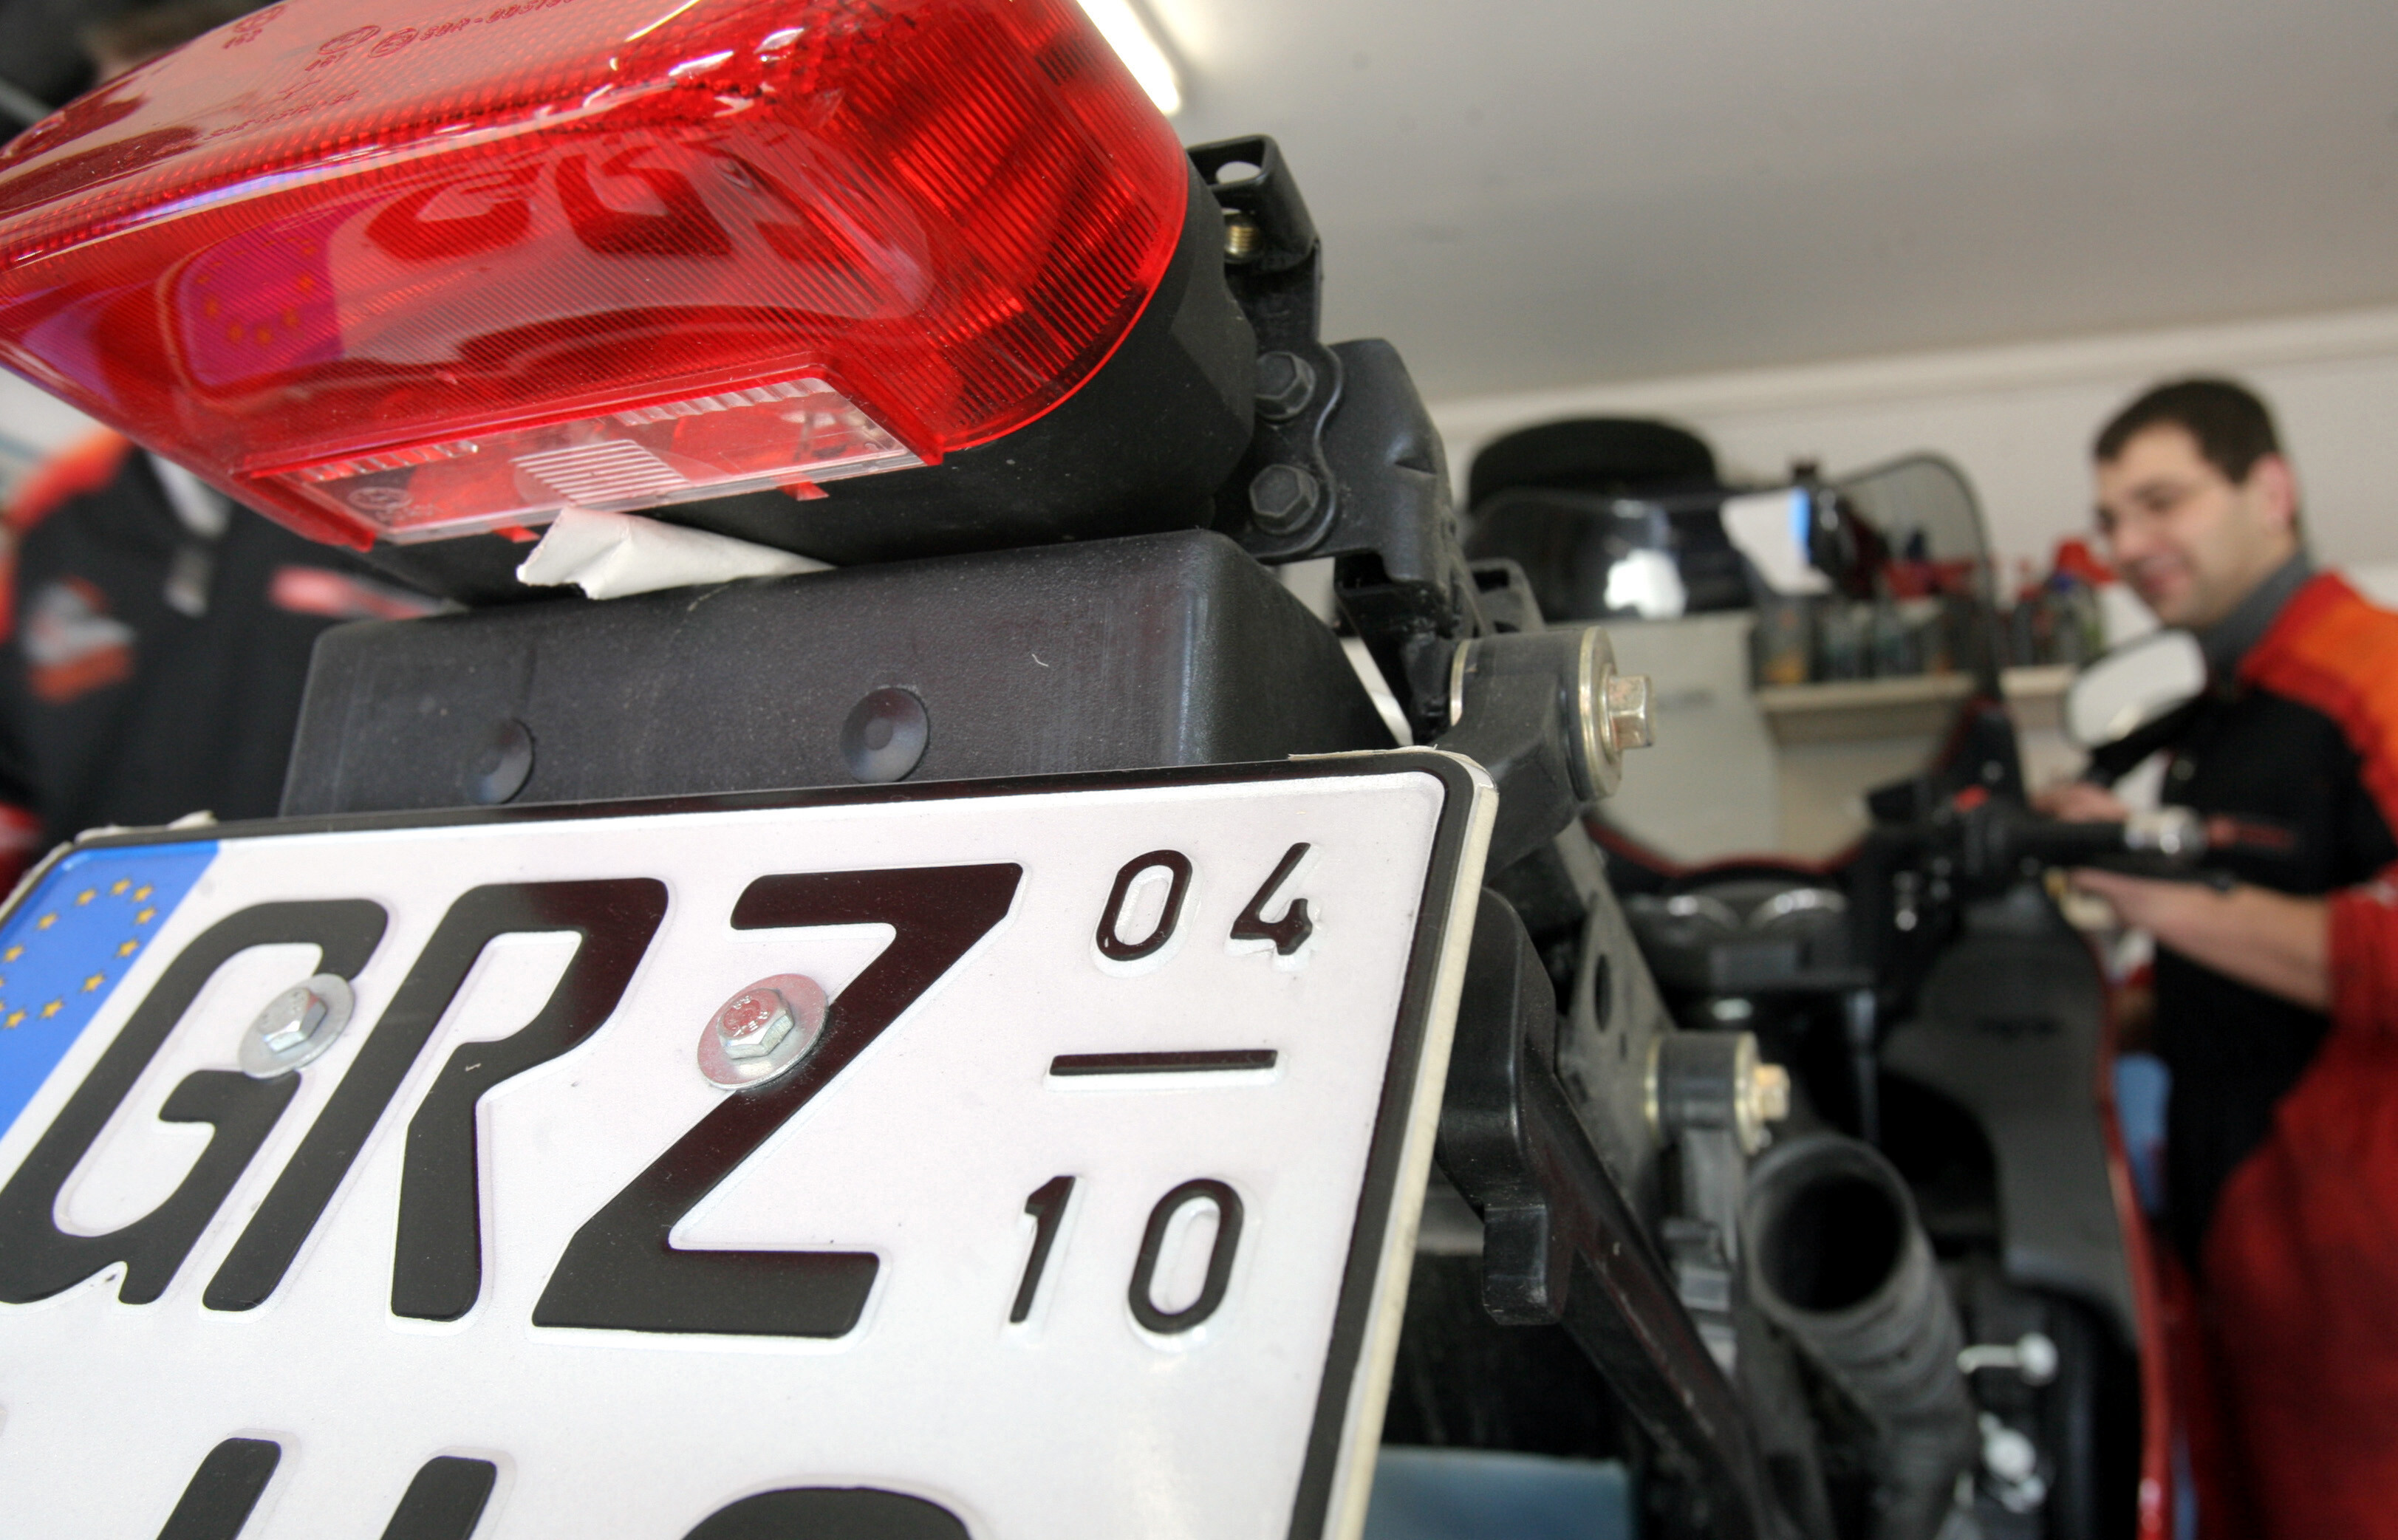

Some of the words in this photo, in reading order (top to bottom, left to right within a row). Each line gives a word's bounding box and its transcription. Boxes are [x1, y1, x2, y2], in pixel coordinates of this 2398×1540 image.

[1096, 842, 1313, 956] 04
[0, 862, 1024, 1339] GRZ
[1009, 1175, 1245, 1335] 10
